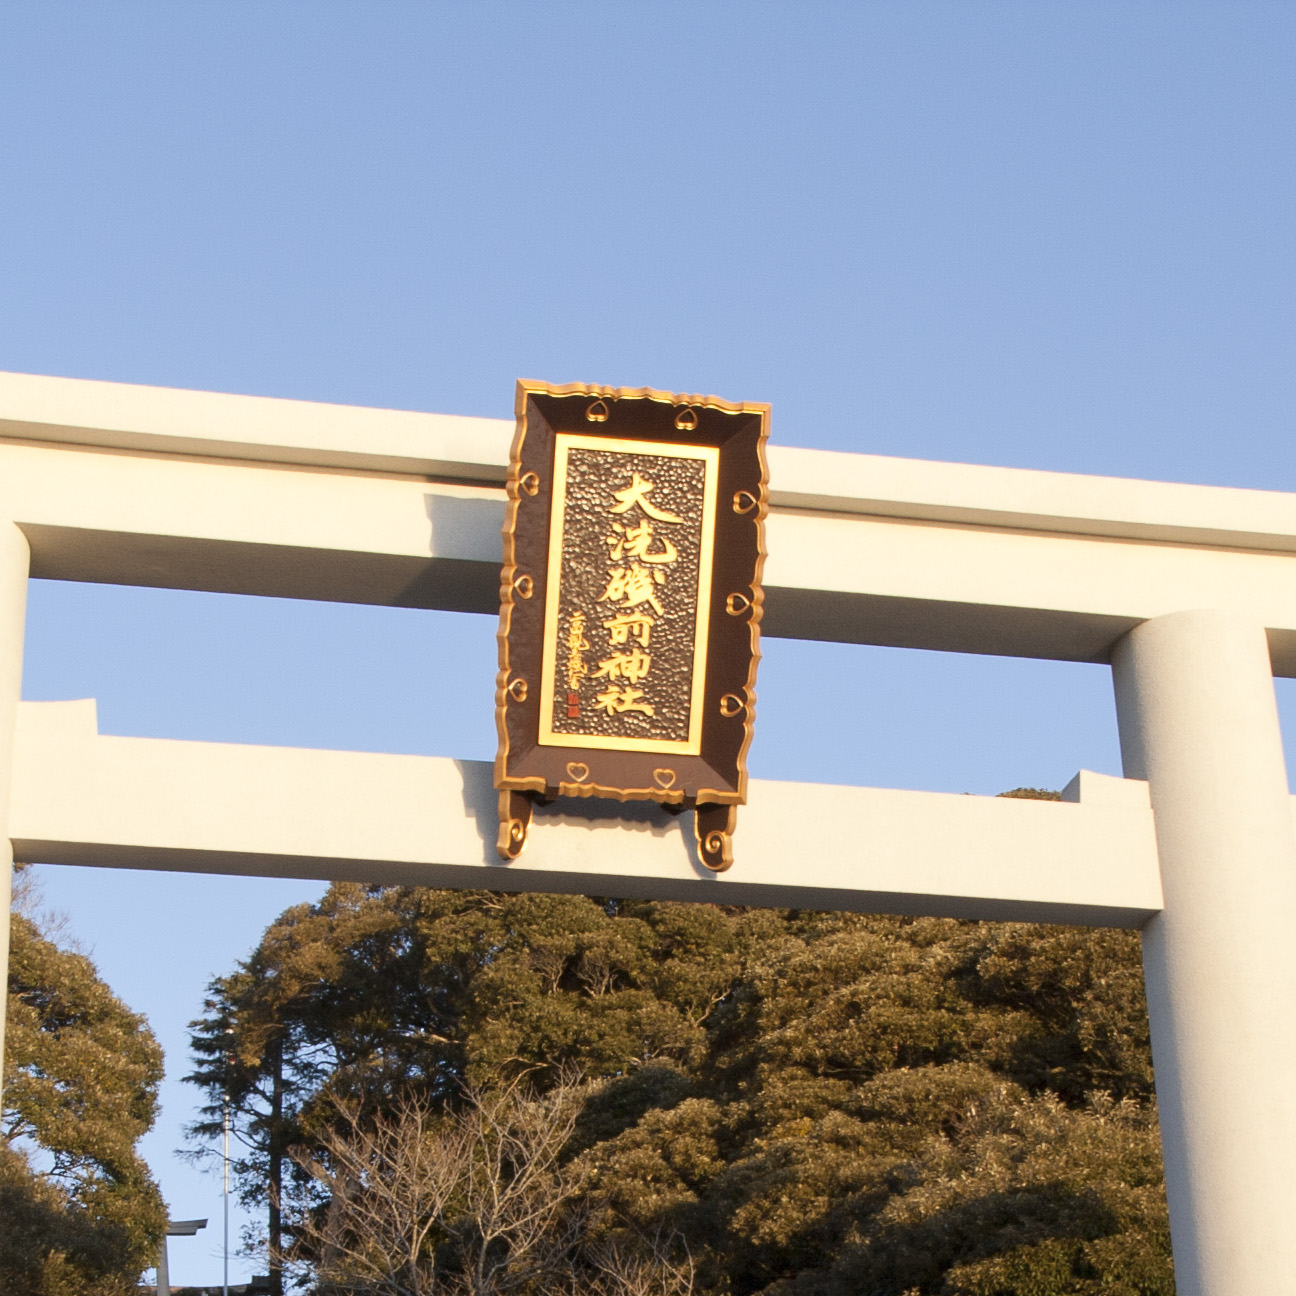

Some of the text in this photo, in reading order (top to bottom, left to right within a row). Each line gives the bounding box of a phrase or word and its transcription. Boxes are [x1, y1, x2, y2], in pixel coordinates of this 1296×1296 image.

[591, 473, 684, 717] 大洗磯前神社
